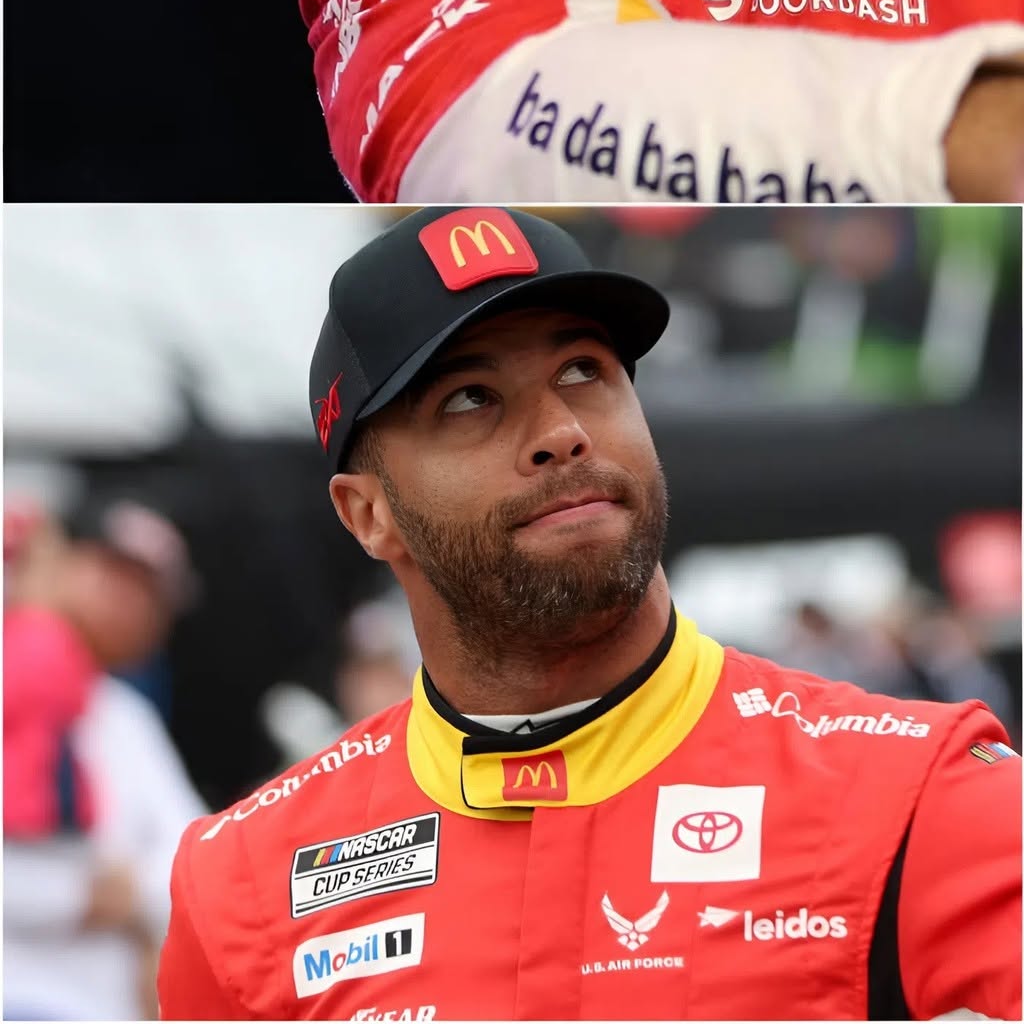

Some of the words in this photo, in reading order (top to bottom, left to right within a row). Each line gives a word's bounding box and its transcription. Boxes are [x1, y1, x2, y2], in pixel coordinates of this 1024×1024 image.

[507, 72, 560, 151] ba
[563, 102, 621, 177] da
[634, 121, 699, 201] ba
[338, 824, 417, 862] NASCAR
[313, 871, 350, 896] CUP
[352, 854, 416, 886] SERIES
[744, 908, 848, 942] leidos
[303, 933, 379, 982] Mobil
[607, 960, 631, 971] AIR
[634, 957, 684, 969] FORCE
